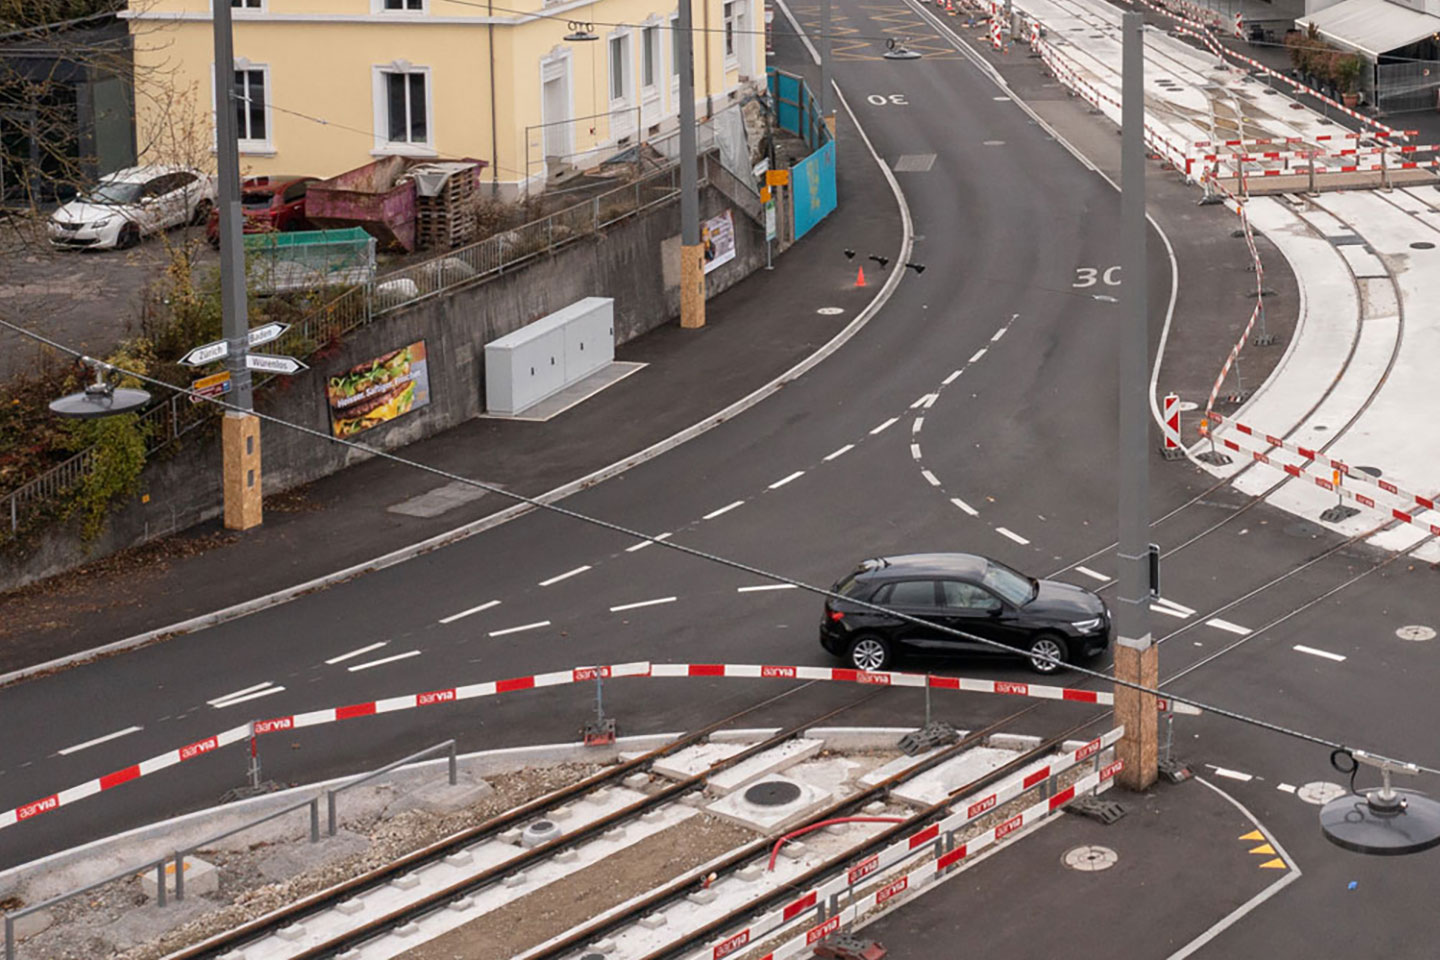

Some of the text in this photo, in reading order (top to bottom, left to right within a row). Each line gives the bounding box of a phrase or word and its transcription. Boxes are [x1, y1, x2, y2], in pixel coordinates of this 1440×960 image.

[867, 94, 909, 106] 30
[249, 329, 272, 342] Baden
[199, 346, 223, 361] Zürich
[252, 358, 288, 370] Würenlos
[763, 667, 795, 678] aarvia
[858, 672, 890, 685] aarvia
[419, 690, 454, 705] aarvia
[255, 719, 291, 733] aarvia
[182, 739, 216, 760] aarvia
[19, 796, 56, 819] aarvia
